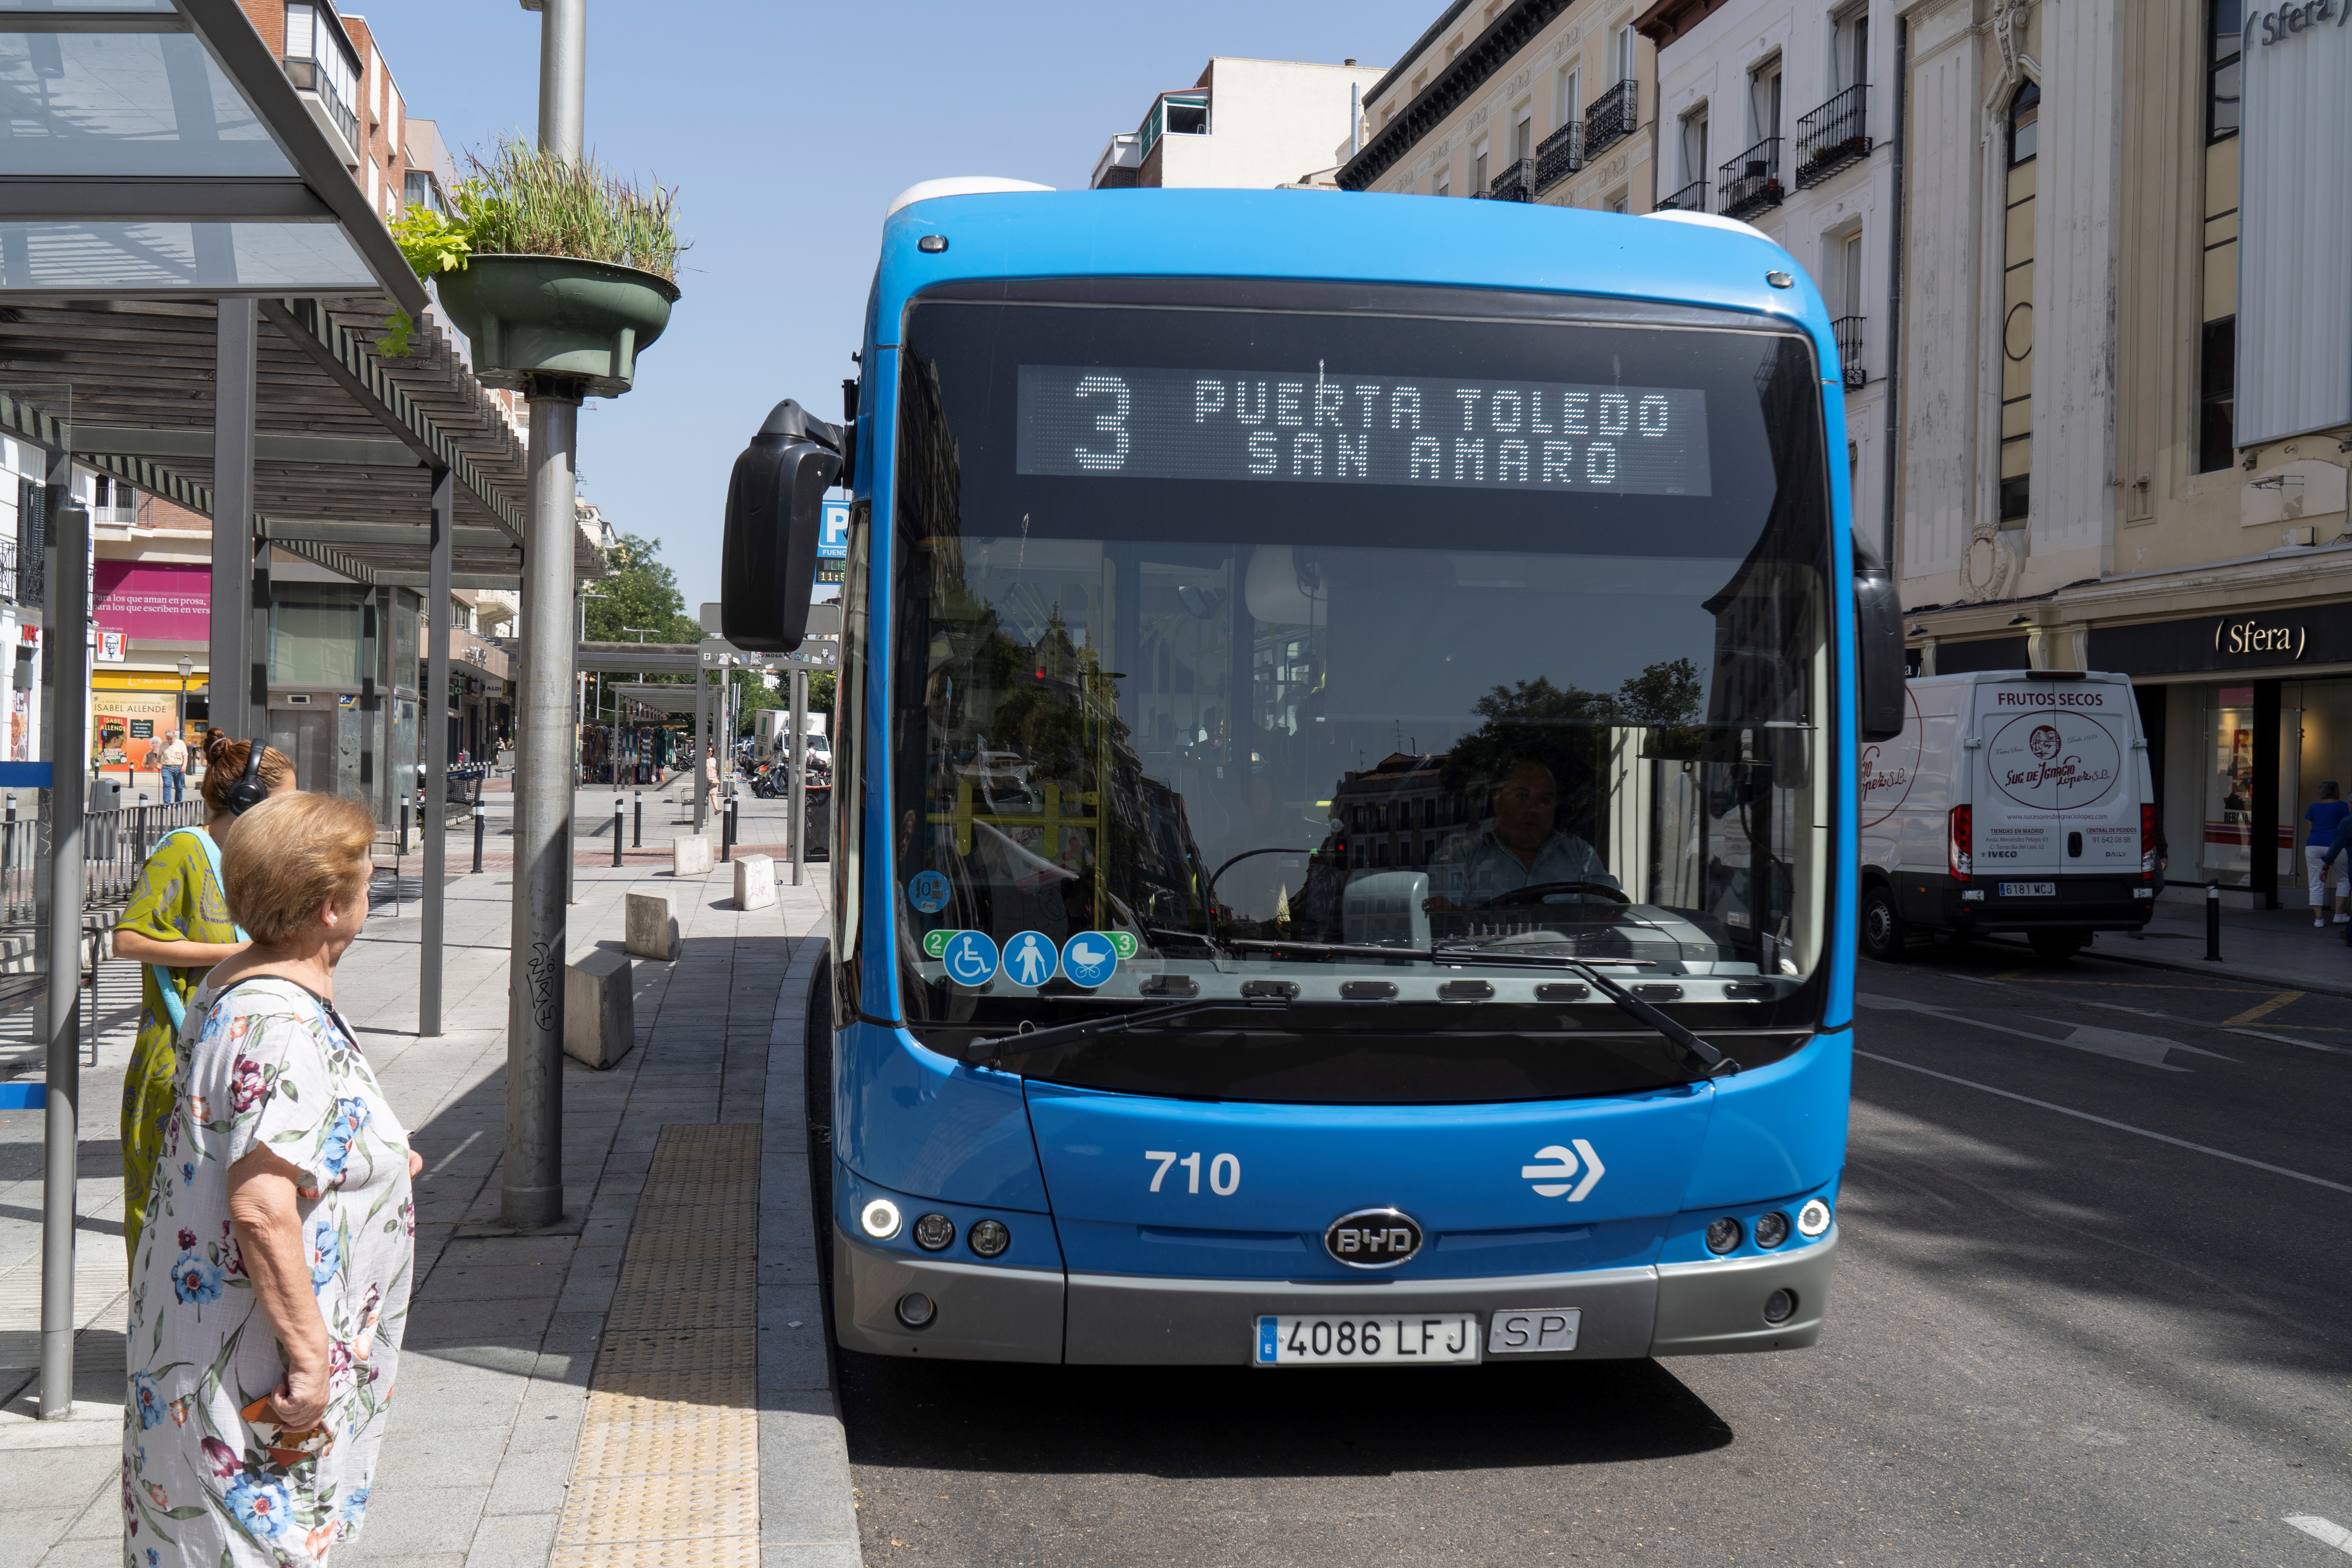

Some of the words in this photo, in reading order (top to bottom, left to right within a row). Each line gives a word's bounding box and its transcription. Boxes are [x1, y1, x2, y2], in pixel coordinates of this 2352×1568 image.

[1196, 380, 1421, 430] PUERTA
[1456, 389, 1668, 437] TOLEDO
[1075, 376, 1129, 470] 3
[1248, 432, 1368, 477] SAN
[1410, 437, 1616, 484] AMARO
[827, 507, 849, 543] P
[93, 594, 111, 602] Para
[113, 594, 125, 602] los
[127, 596, 142, 605] que
[180, 598, 206, 607] prosa,
[126, 606, 142, 614] que
[143, 605, 179, 613] escriben
[23, 624, 38, 642] KFC
[1998, 693, 2055, 706] FRUTOS
[2058, 693, 2103, 706] SECOS
[2006, 884, 2031, 894] 6181
[2034, 884, 2053, 894] MCJ
[931, 934, 942, 949] 2
[1119, 935, 1130, 951] 3
[1145, 1151, 1241, 1196] 710
[1336, 1228, 1412, 1253] BYD
[1265, 1343, 1272, 1354] E
[1287, 1320, 1381, 1356] 4086
[1397, 1319, 1466, 1355] LFJ
[1504, 1316, 1566, 1347] SP
